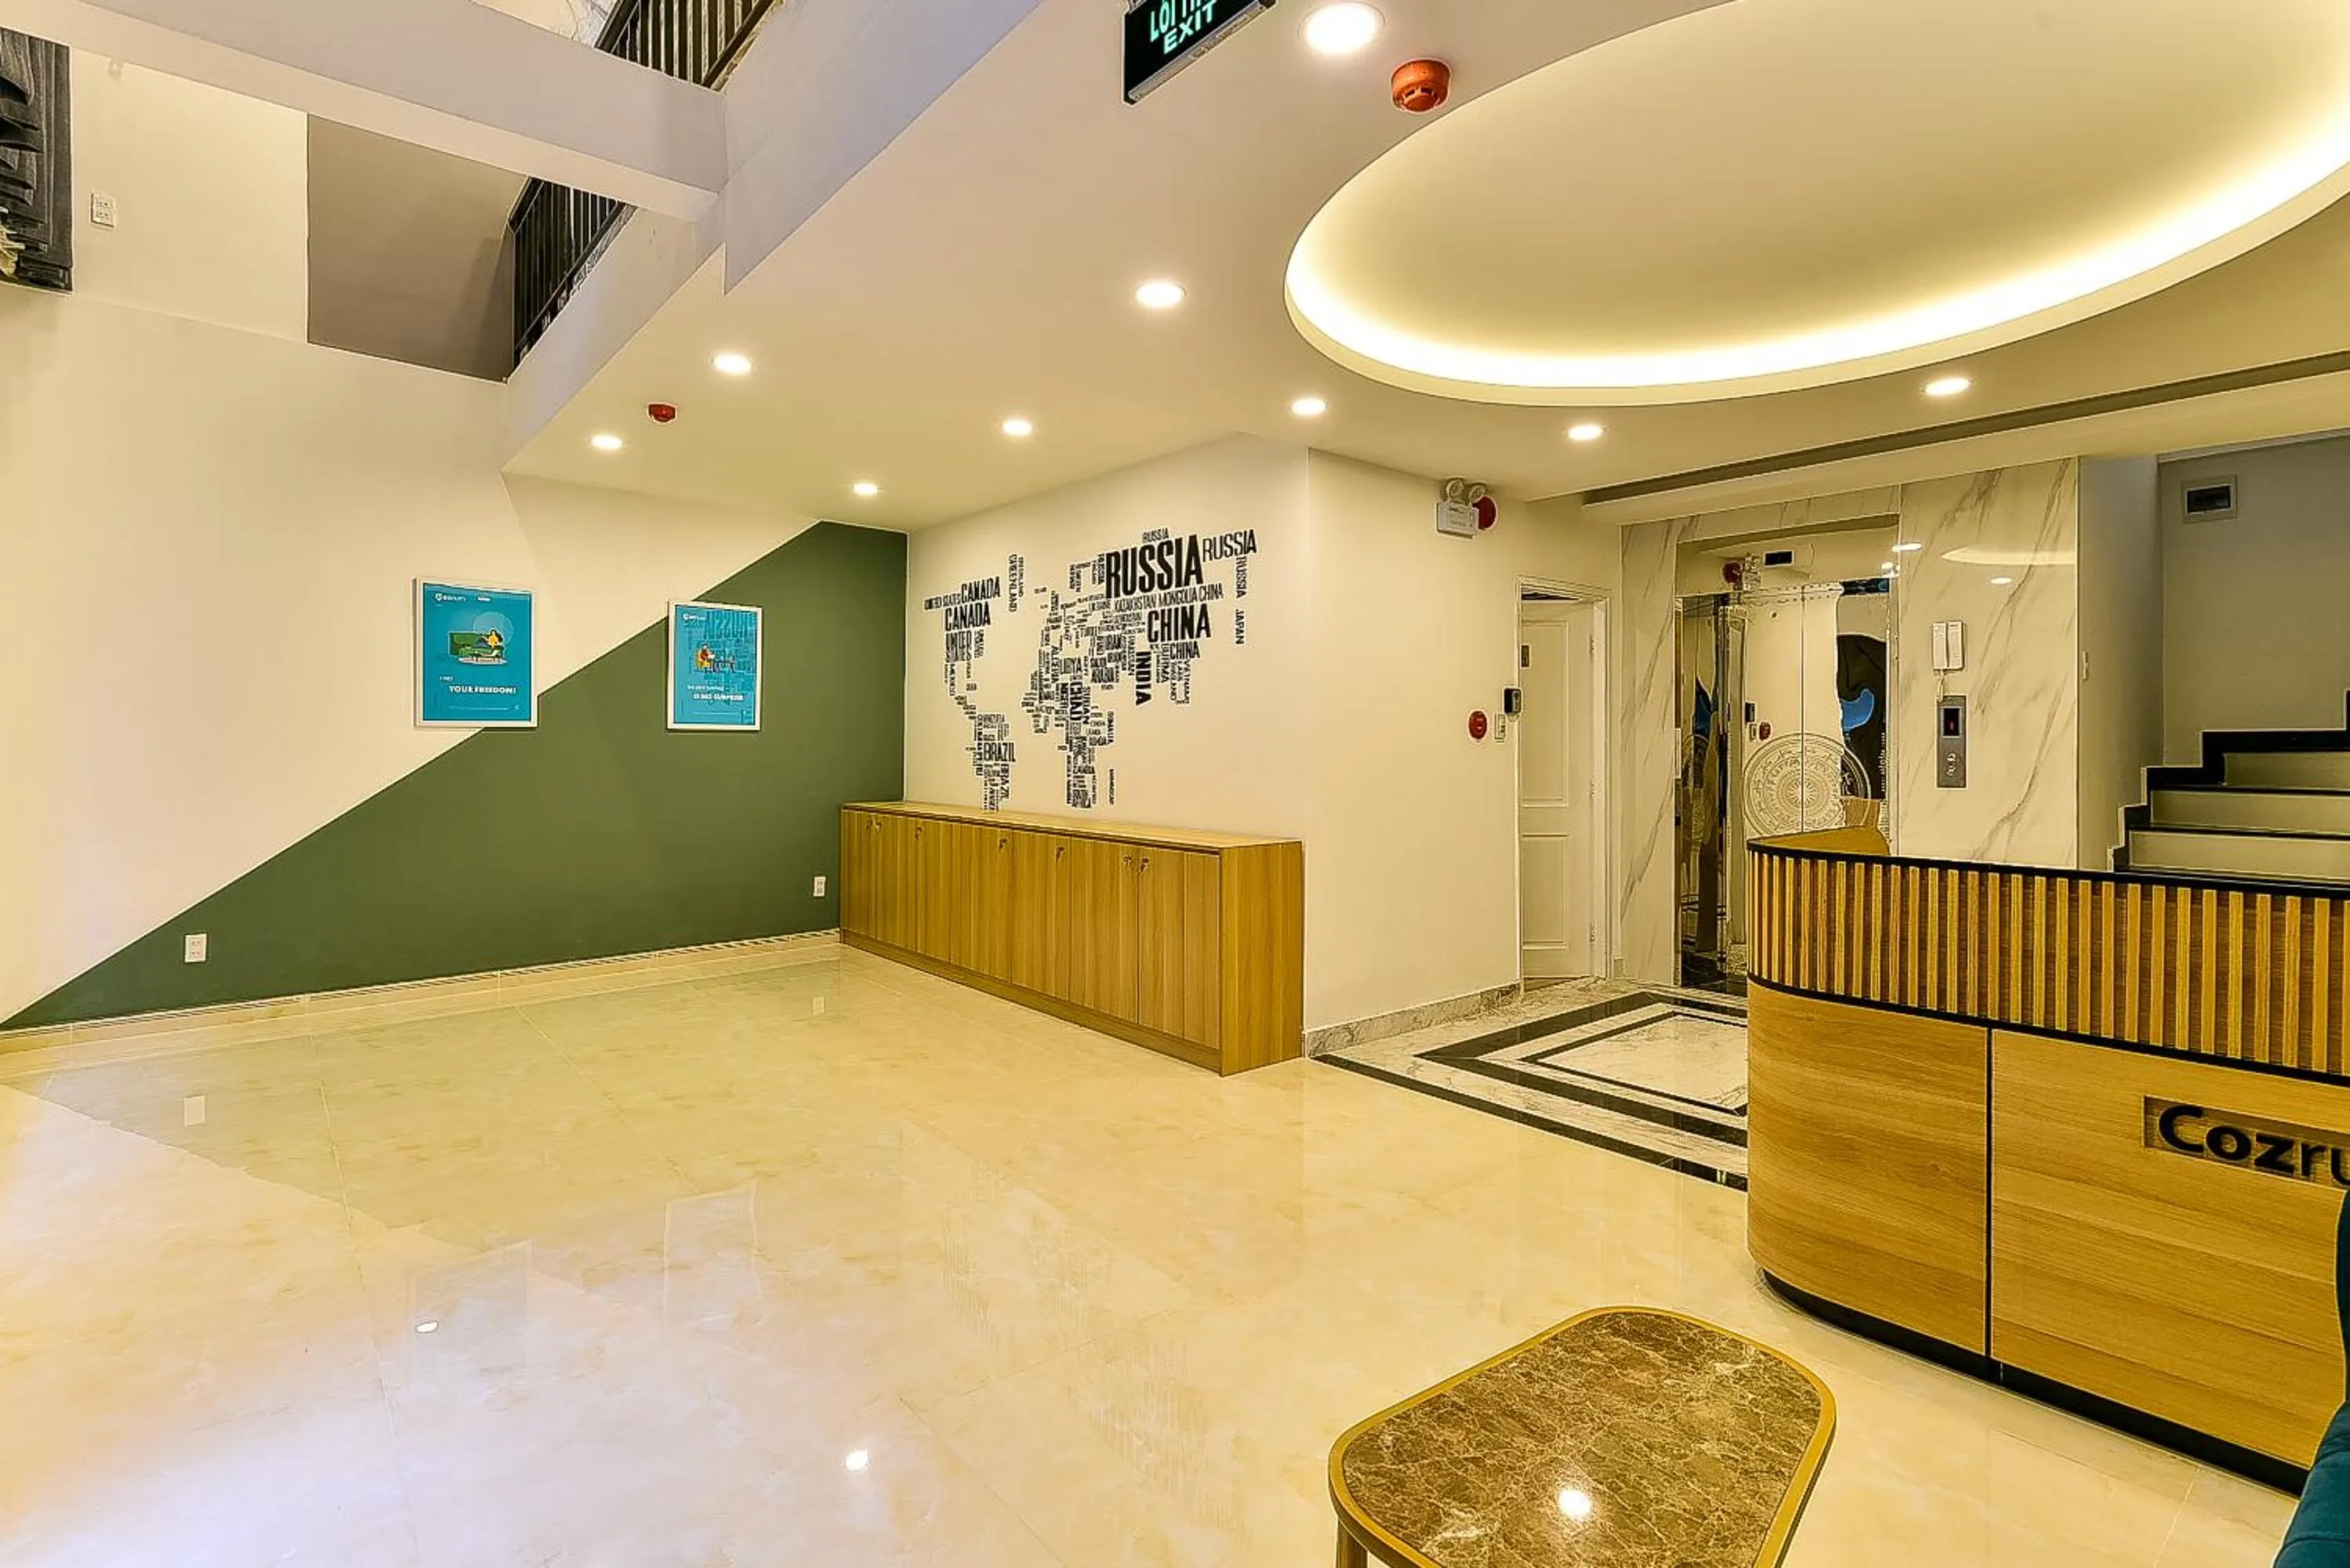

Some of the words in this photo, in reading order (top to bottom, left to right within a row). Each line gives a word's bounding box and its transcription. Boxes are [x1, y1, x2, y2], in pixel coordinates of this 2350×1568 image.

[1163, 0, 1216, 55] EXIT
[1143, 528, 1169, 541] RUSSIA
[1202, 530, 1257, 562] RUSSIA
[1106, 534, 1203, 599] RUSSIA
[1236, 556, 1247, 599] RUSSIA
[961, 576, 1001, 603] CANADA
[1199, 583, 1224, 602] CHINA
[945, 601, 991, 632] CANADA
[1148, 603, 1211, 643] CHINA
[1235, 610, 1244, 644] JAPAN
[1170, 641, 1200, 659] CHINA
[449, 685, 474, 693] YOUR
[1136, 652, 1151, 705] INDIA
[984, 742, 1016, 762] BRAZIL
